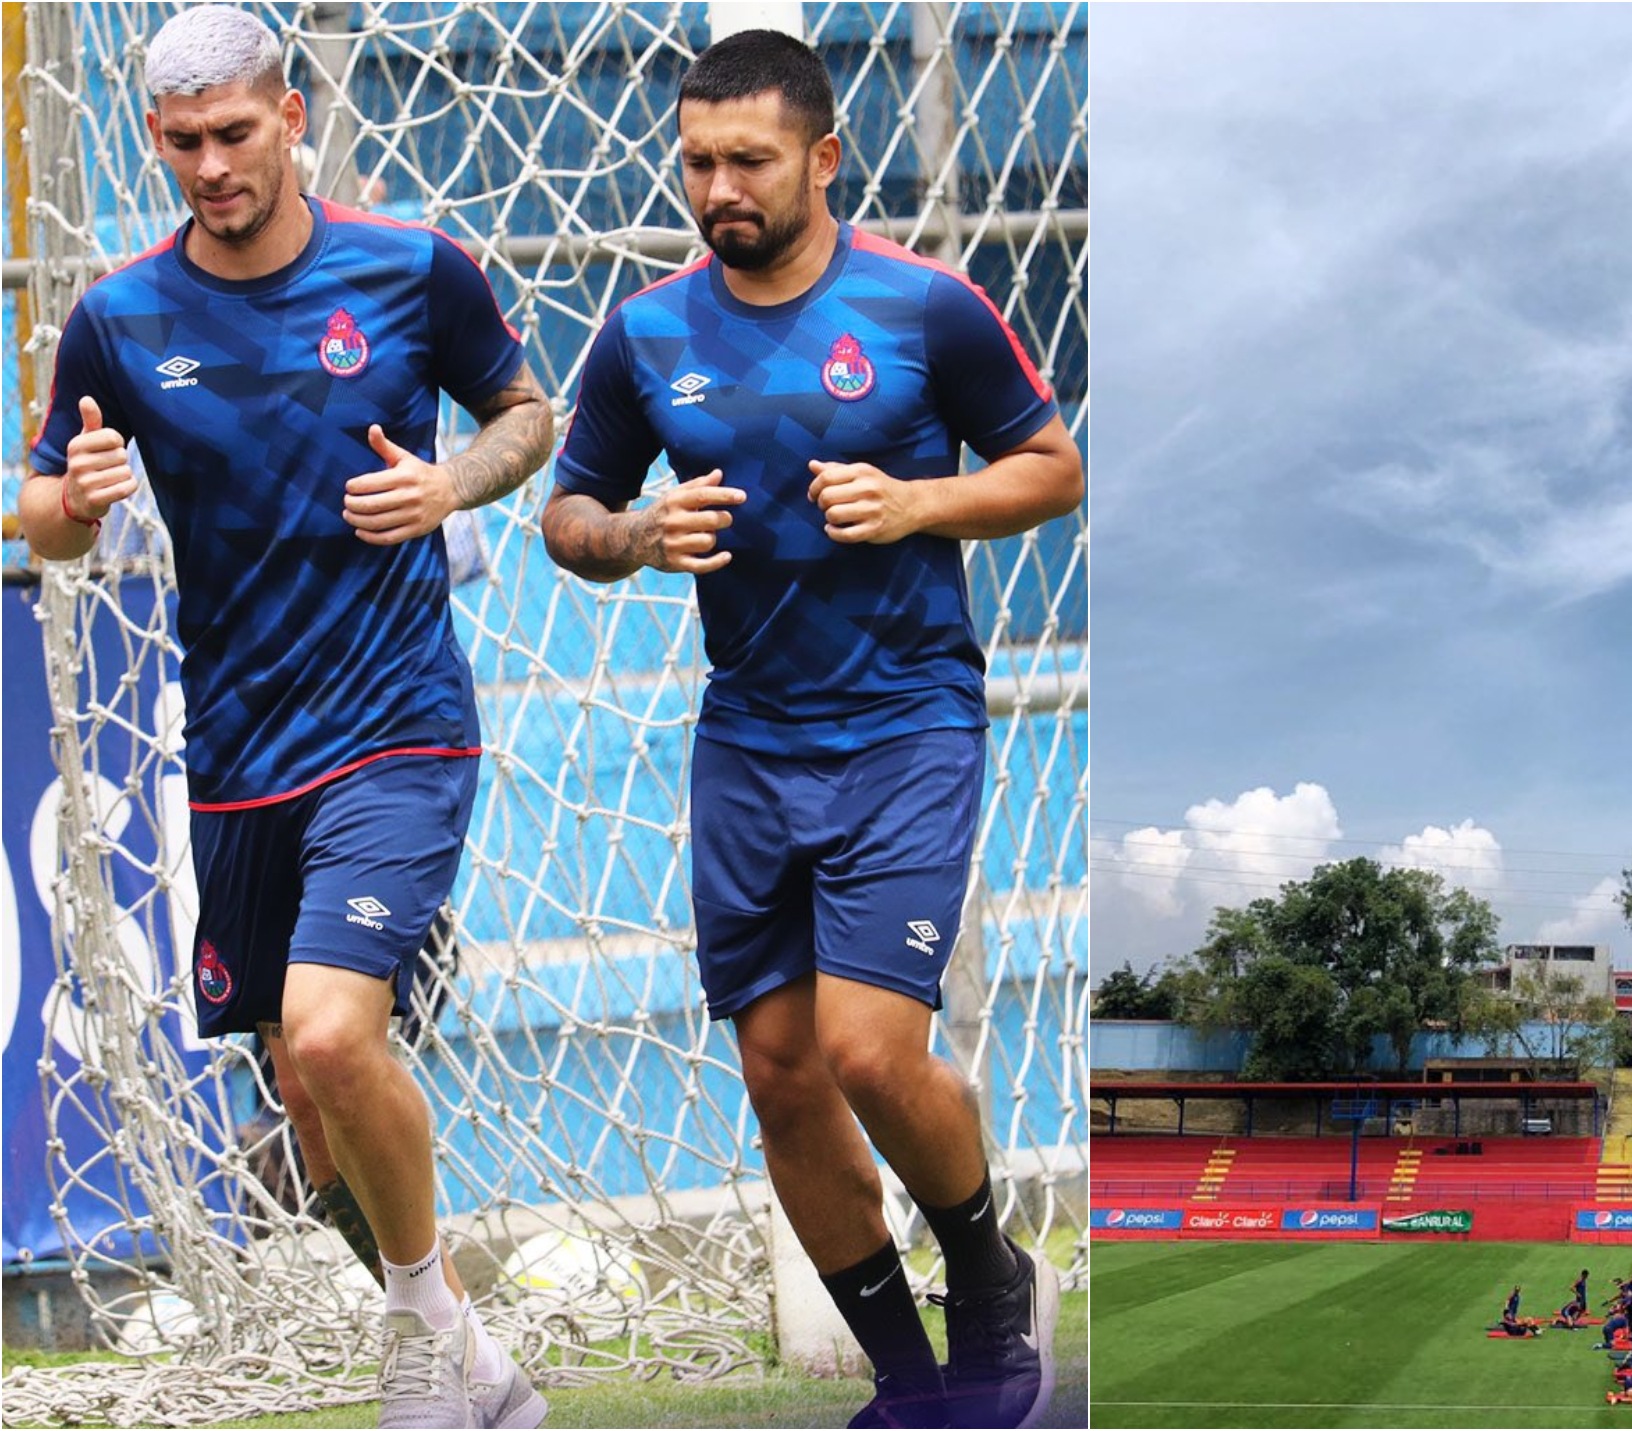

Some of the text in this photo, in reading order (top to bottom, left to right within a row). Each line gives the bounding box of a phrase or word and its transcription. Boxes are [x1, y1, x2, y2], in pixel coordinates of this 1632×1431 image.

[161, 377, 198, 389] umbro
[672, 394, 705, 406] umbro
[346, 914, 384, 930] umbro
[906, 937, 934, 956] umbro
[1125, 1213, 1165, 1226] pepsi
[1190, 1213, 1269, 1227] Claro Claro
[1320, 1213, 1358, 1226] pepsi
